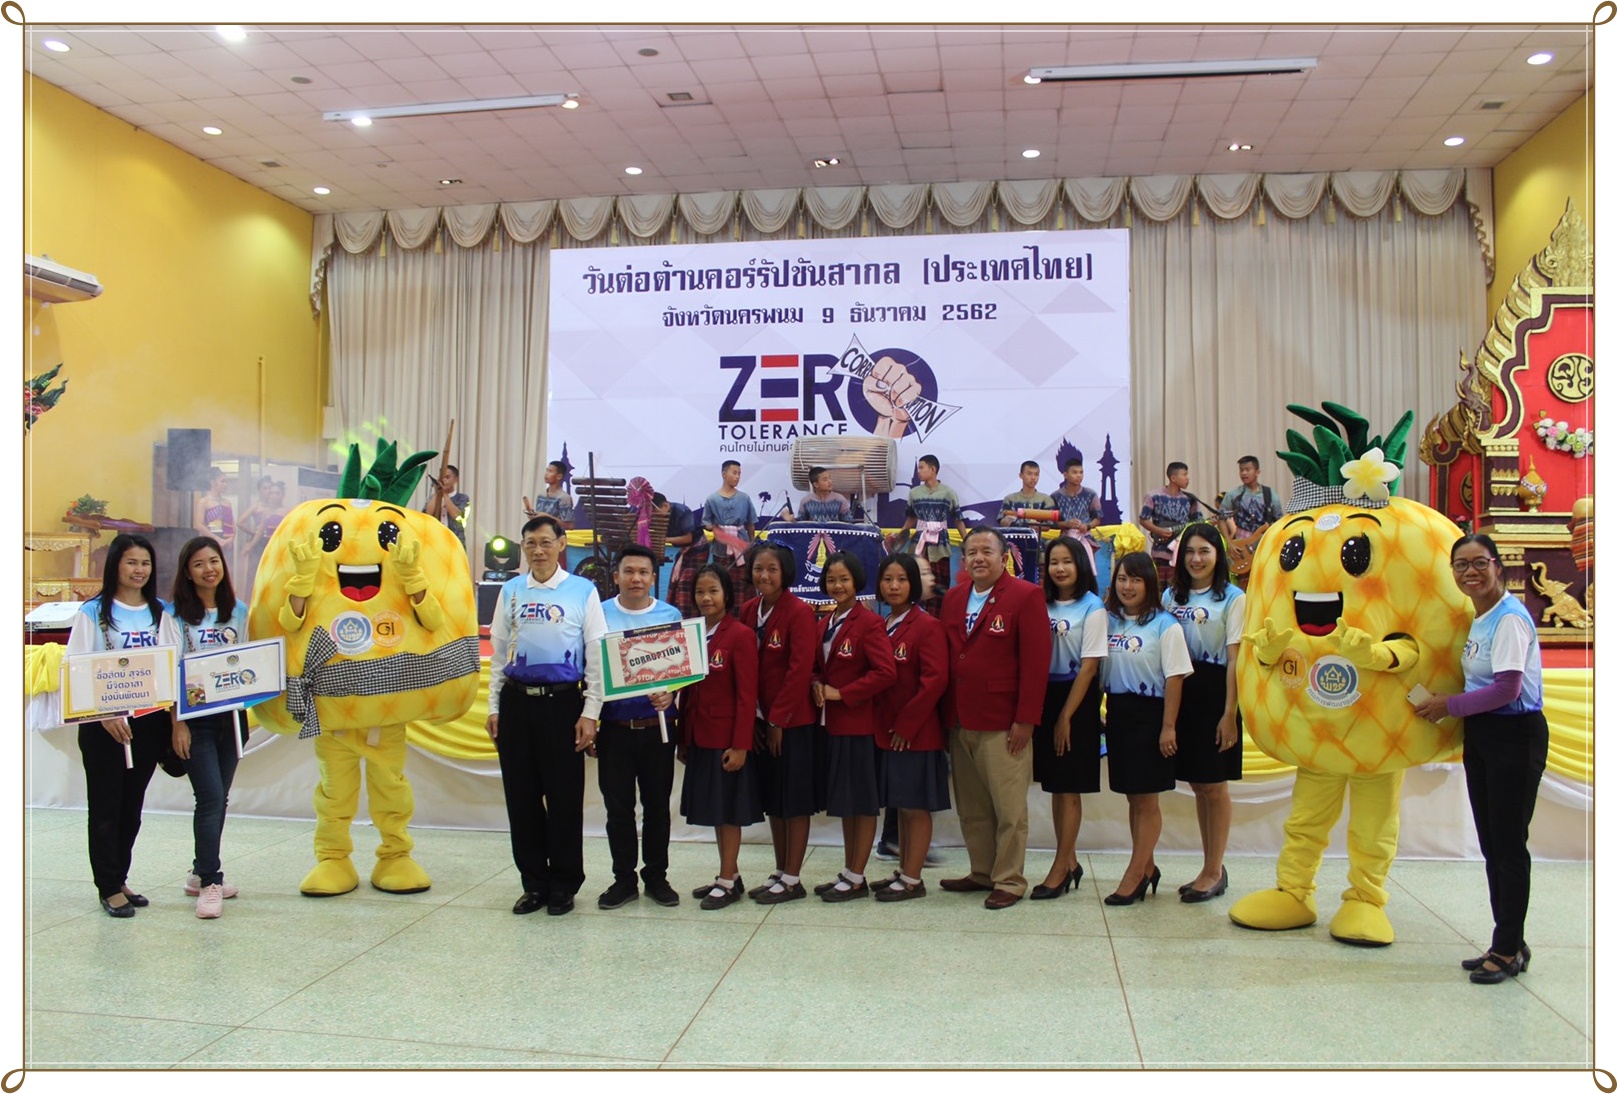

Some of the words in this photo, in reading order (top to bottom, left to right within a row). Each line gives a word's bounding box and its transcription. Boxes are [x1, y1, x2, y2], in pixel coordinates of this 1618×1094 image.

[582, 257, 900, 294] วันต่อต้านคอร์รัปชันสากล
[662, 304, 804, 327] จังหวัดนครพนม
[822, 307, 834, 324] 9
[850, 302, 926, 323] ธันวาคม
[942, 303, 997, 322] 2562
[629, 645, 681, 667] CORRUPTION
